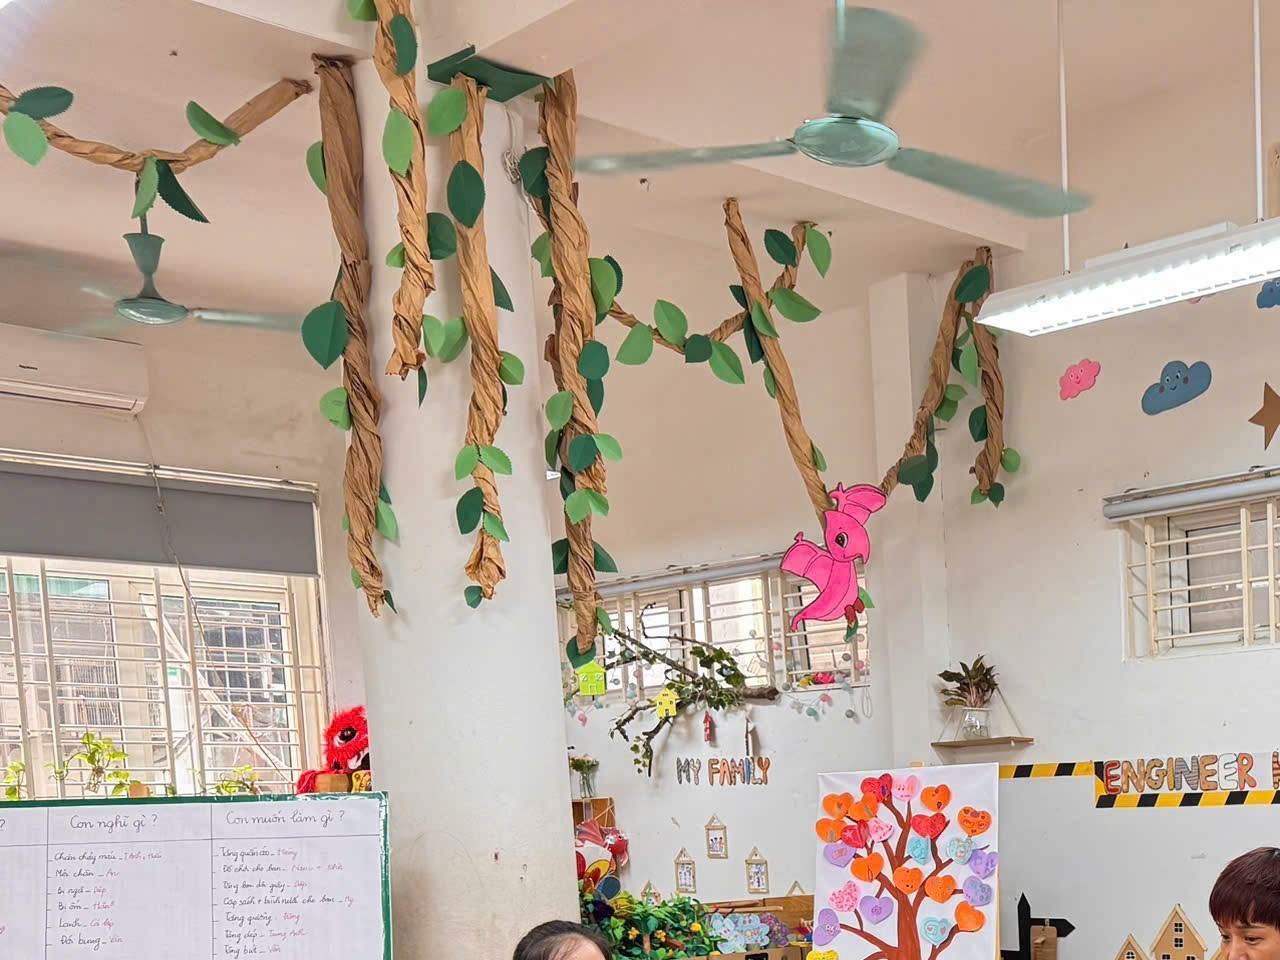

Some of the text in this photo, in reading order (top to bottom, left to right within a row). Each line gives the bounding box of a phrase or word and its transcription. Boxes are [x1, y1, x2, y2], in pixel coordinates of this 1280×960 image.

[676, 756, 770, 786] MY FAMILY
[1103, 752, 1257, 794] ENGINEER
[70, 814, 94, 829] Con
[98, 814, 129, 834] nghĩ
[133, 814, 146, 833] gì
[226, 811, 249, 825] Con
[251, 810, 286, 824] muốn
[290, 810, 317, 823] làm
[320, 810, 333, 828] gì
